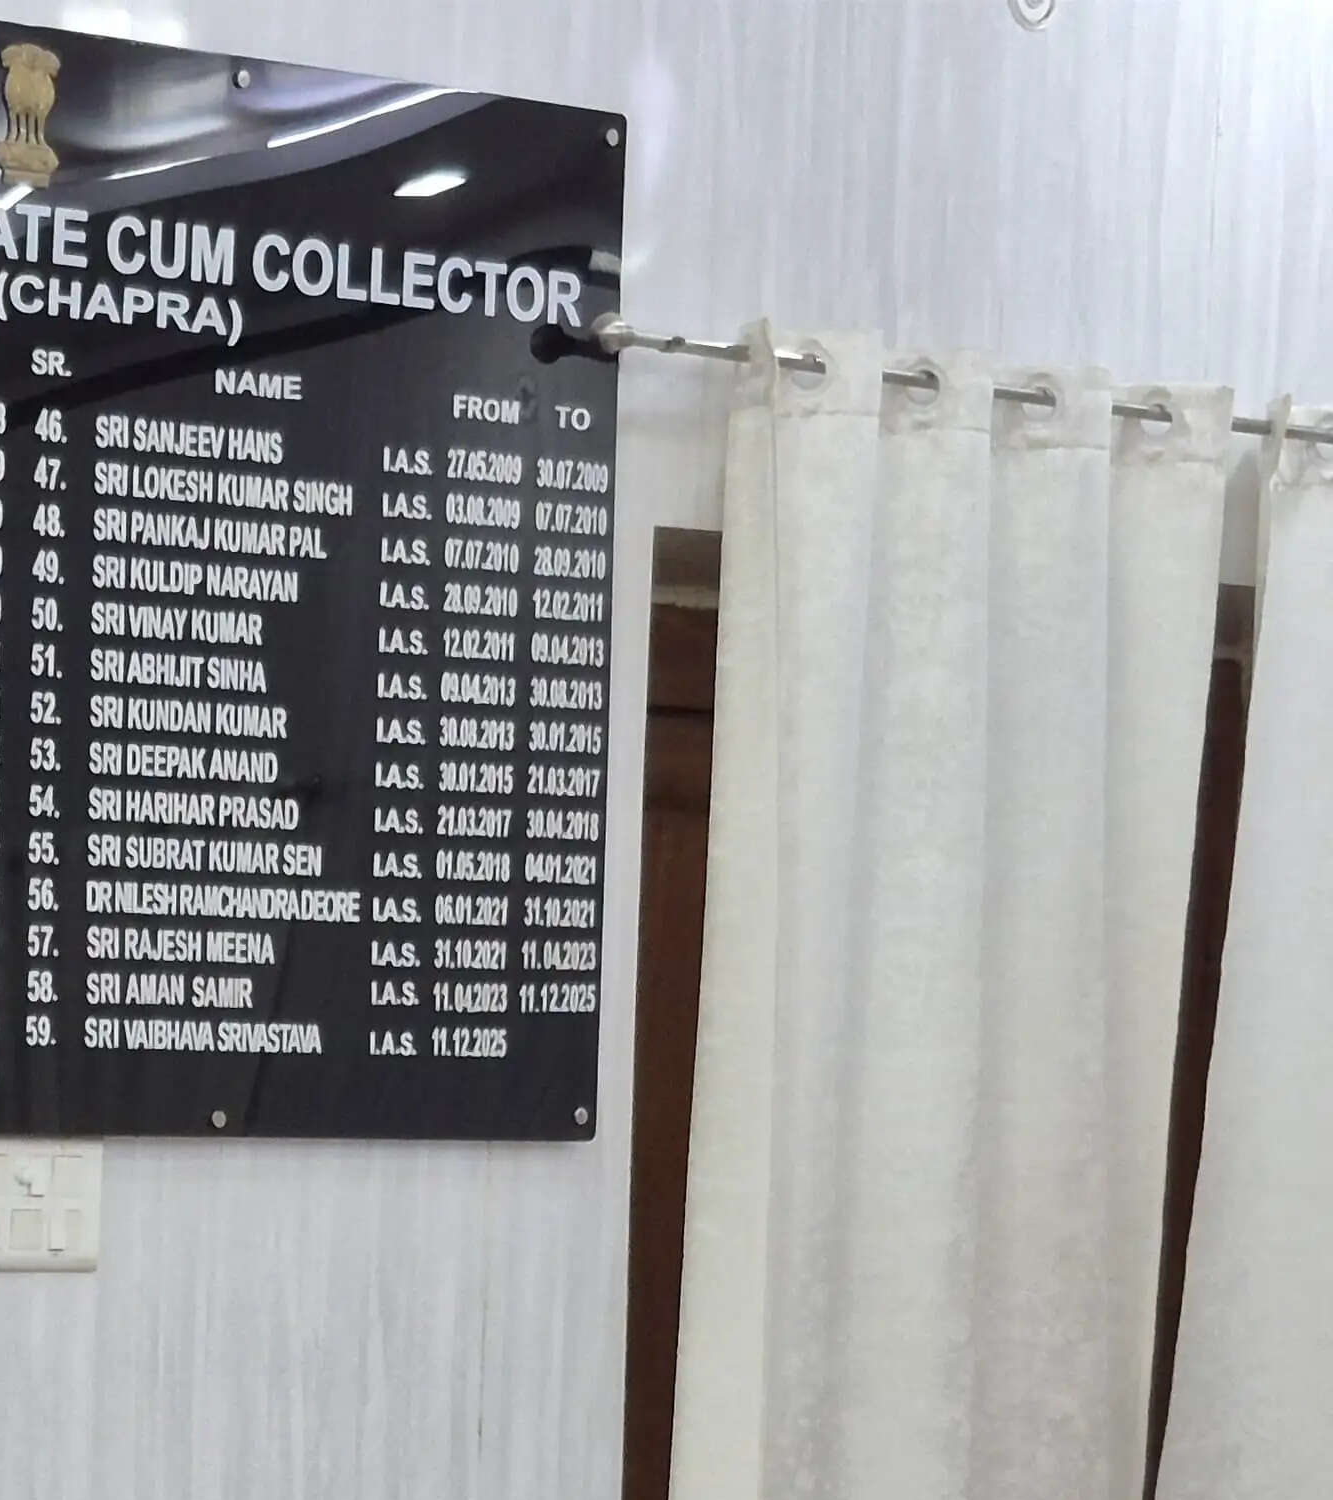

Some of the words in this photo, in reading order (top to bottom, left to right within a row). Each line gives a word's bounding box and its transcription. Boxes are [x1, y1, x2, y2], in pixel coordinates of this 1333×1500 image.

[107, 216, 237, 285] CUM
[253, 234, 582, 327] COLLECTOR
[31, 348, 72, 377] SR.
[215, 368, 303, 401] NAME
[453, 394, 521, 425] FROM
[554, 405, 591, 431] TO
[34, 407, 68, 444] 46.
[95, 414, 129, 449] SRI
[132, 417, 226, 459] SANJEEV
[228, 427, 283, 465] HANS
[33, 455, 67, 491] 47.
[94, 461, 129, 497] SRI
[132, 465, 214, 503] LOKESH
[217, 472, 290, 512] KUMAR
[292, 479, 353, 516] SINGH
[32, 503, 65, 538] 48.
[93, 507, 127, 543] SRI
[130, 510, 211, 550] PANKAJ
[213, 518, 286, 556] KUMAR
[289, 525, 328, 559] PAL
[32, 549, 65, 585] 49.
[92, 554, 126, 589] SRI
[129, 557, 203, 596] KULDIP
[206, 564, 298, 603] NARAYAN
[31, 597, 63, 632] 50.
[90, 601, 125, 636] SRI
[128, 604, 188, 641] VINAY
[191, 608, 263, 646] KUMAR
[378, 627, 429, 655] I.A.S.
[443, 627, 515, 662] 12.02.2011
[30, 643, 63, 679] 51.
[90, 648, 125, 683] SRI
[126, 651, 205, 689] ABHIJIT
[206, 656, 267, 693] SINHA
[30, 691, 62, 725] 52.
[89, 694, 124, 729] SRI
[127, 697, 212, 734] KUNDAN
[215, 702, 287, 739] KUMAR
[29, 737, 61, 771] 53.
[88, 741, 123, 776] SRI
[126, 743, 206, 780] DEEPAK
[208, 748, 279, 784] ANAND
[28, 784, 60, 819] 54.
[88, 786, 122, 822] SRI
[125, 789, 215, 826] HARIHAR
[218, 794, 299, 830] PRASAD
[28, 831, 60, 865] 55.
[87, 833, 122, 867] SRI
[125, 835, 206, 872] SUBRAT
[208, 840, 280, 875] KUMAR
[282, 843, 322, 877] SEN
[27, 877, 59, 911] 56.
[86, 880, 113, 914] DR
[114, 880, 178, 916] NILESH
[179, 884, 300, 921] RAMCHANDRA
[301, 889, 361, 923] DEORE
[27, 924, 59, 957] 57.
[86, 925, 120, 960] SRI
[124, 927, 202, 962] RAJESH
[206, 930, 275, 965] MEENA
[27, 970, 58, 1003] 58.
[86, 972, 121, 1005] SRI
[125, 973, 185, 1006] AMAN
[191, 975, 253, 1009] SAMIR
[25, 1015, 57, 1047] 59.
[84, 1017, 120, 1049] SRI
[123, 1019, 215, 1052] VAIBHAVA
[216, 1021, 322, 1054] SRIVASTAVA
[369, 1030, 417, 1057] I.A.S.
[431, 1026, 507, 1058] 11.12.2025
